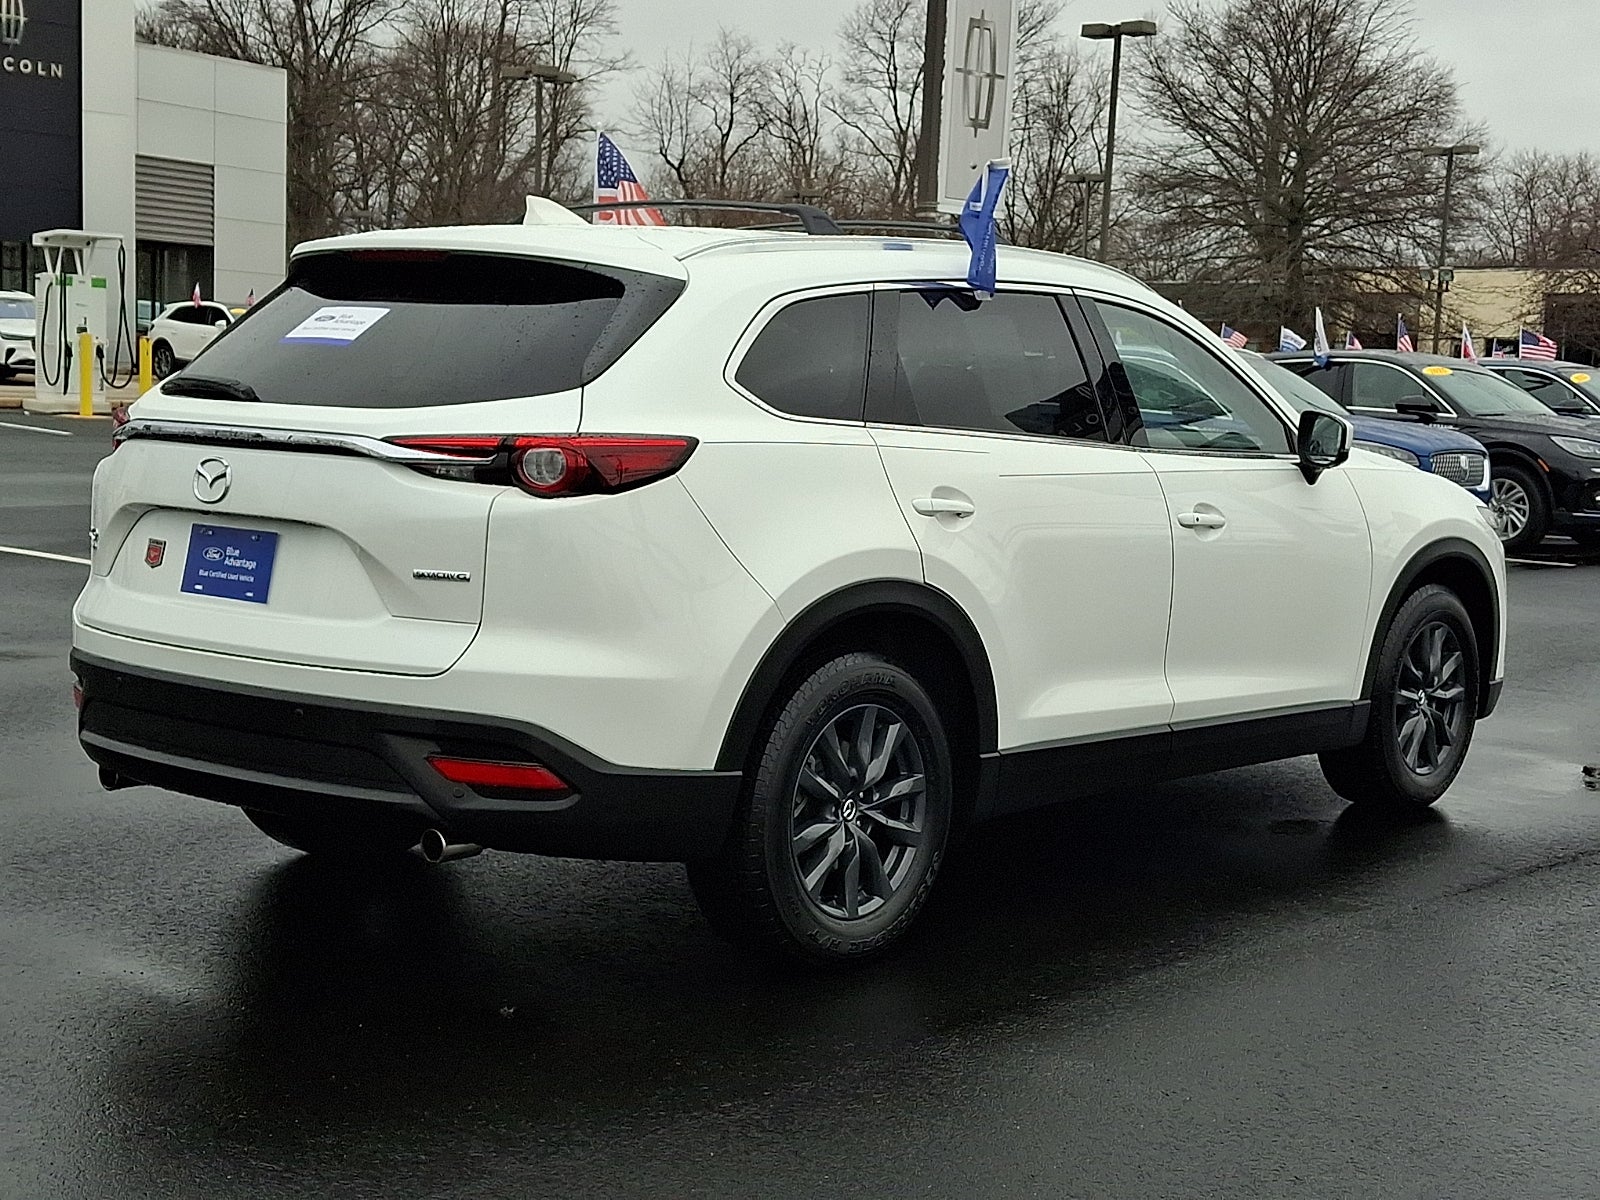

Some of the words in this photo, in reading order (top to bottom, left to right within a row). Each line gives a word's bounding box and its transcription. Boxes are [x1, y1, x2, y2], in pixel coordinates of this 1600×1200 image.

[225, 546, 240, 557] Blue
[224, 556, 257, 570] Advantage
[198, 568, 209, 577] Blue
[208, 569, 228, 580] Certified
[227, 572, 239, 581] Used
[238, 574, 255, 583] Vehicle
